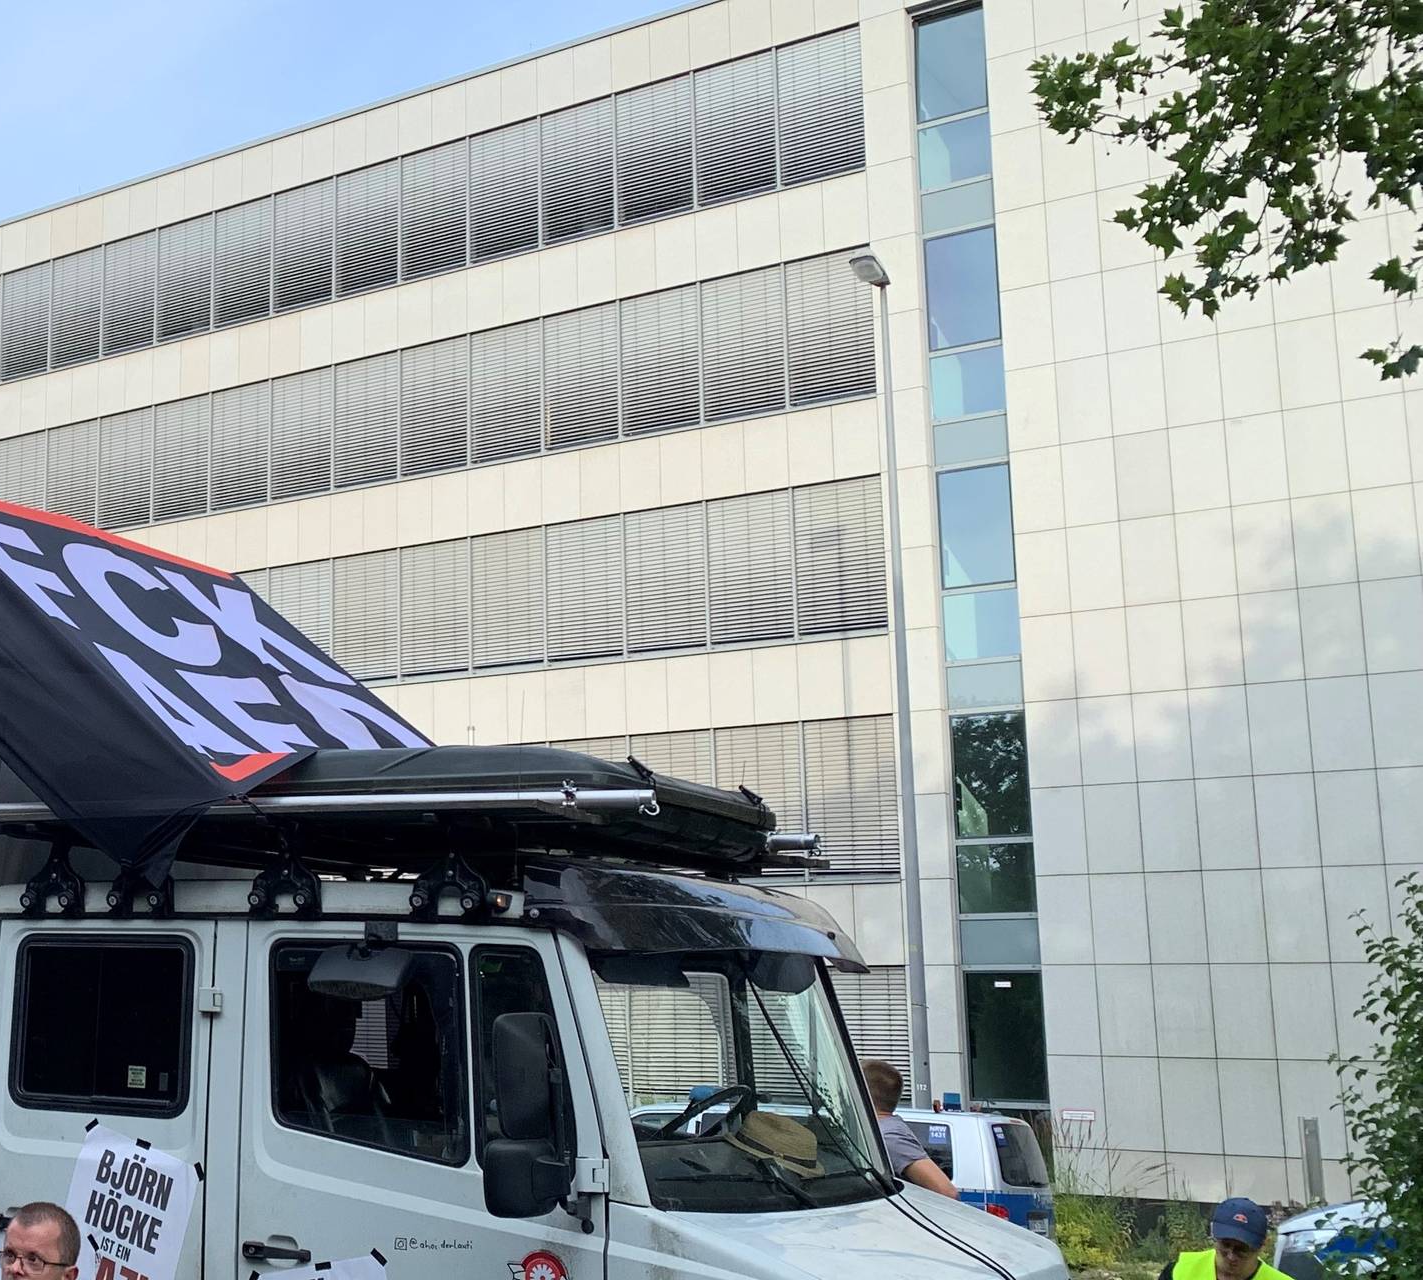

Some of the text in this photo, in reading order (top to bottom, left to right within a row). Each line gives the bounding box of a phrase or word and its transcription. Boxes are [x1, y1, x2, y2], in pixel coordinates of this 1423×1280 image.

[95, 1149, 174, 1211] BJÖRN
[84, 1189, 163, 1255] HÖCKE
[100, 1236, 131, 1262] IST EIN
